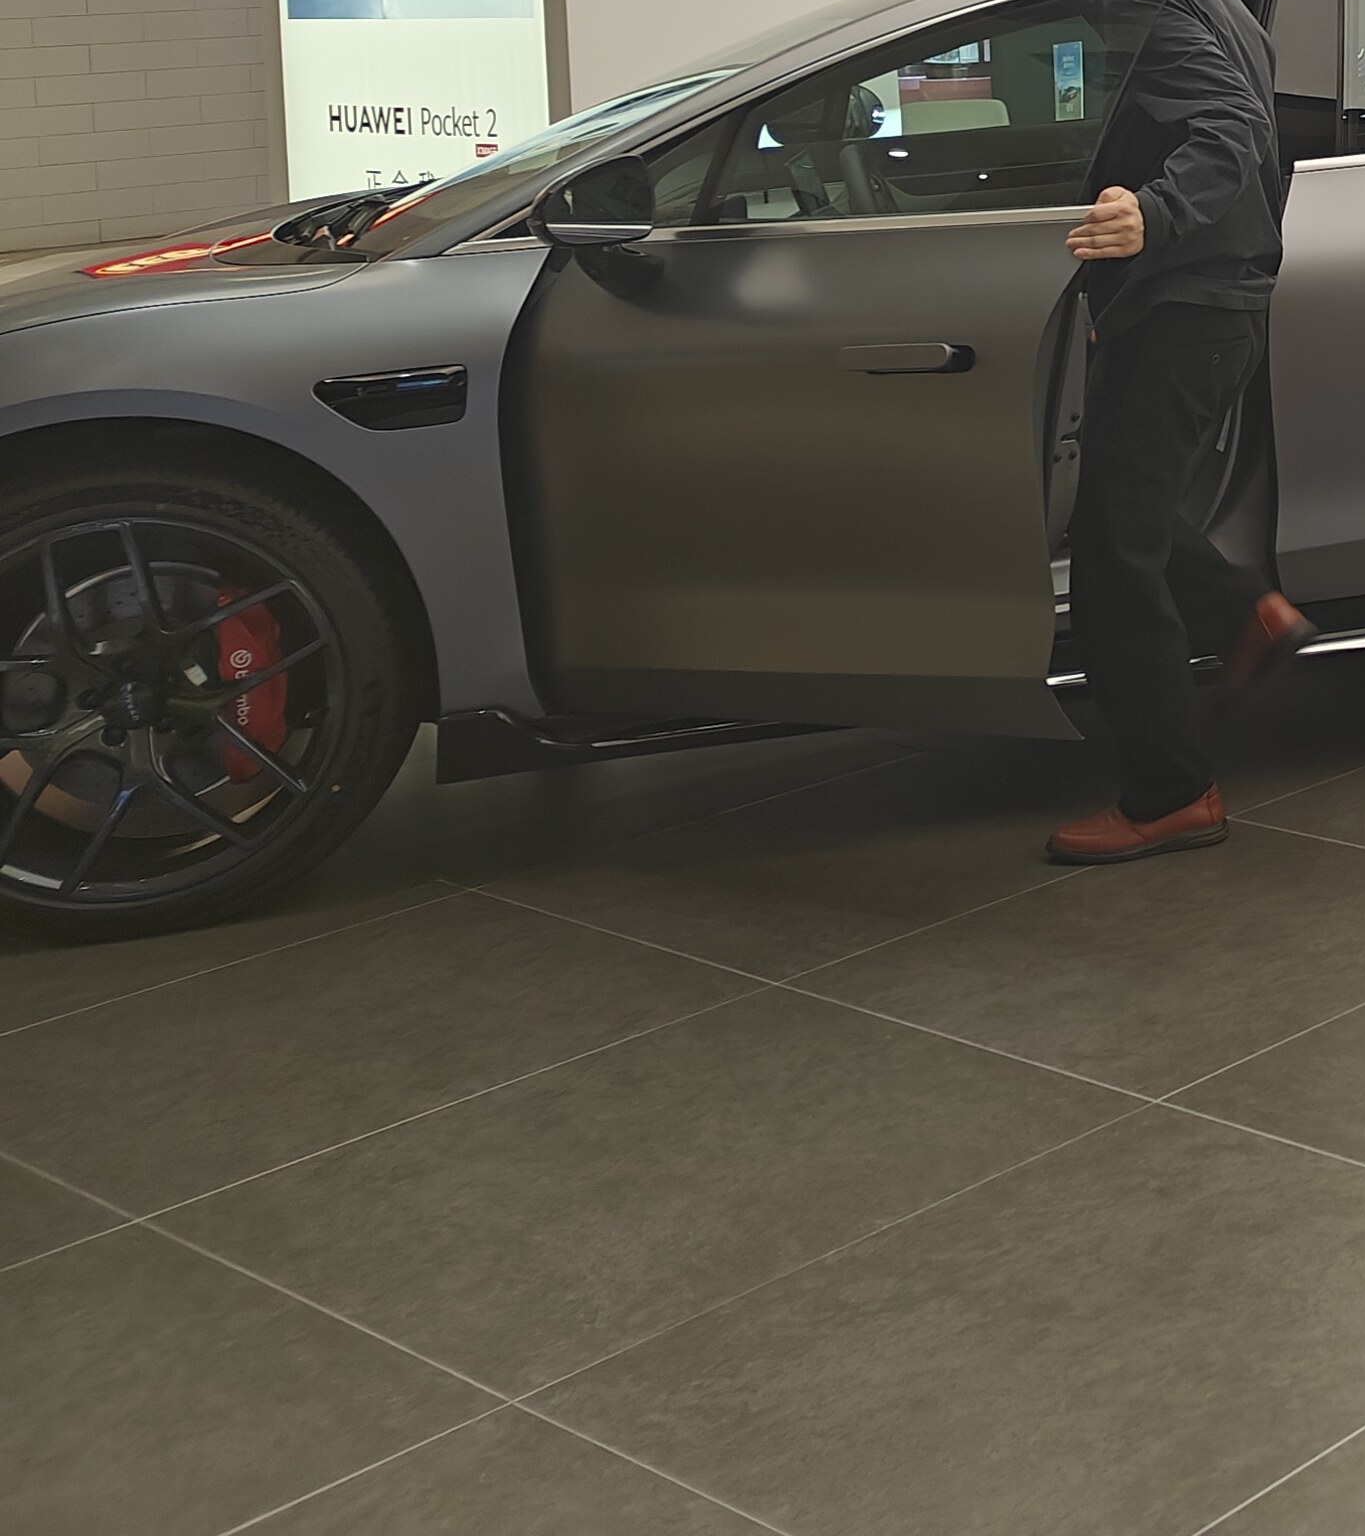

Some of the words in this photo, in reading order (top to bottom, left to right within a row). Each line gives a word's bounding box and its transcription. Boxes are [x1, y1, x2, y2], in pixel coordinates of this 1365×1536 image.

[328, 104, 412, 135] HUAWEI
[420, 106, 480, 137] Pocket
[486, 109, 498, 137] 2
[235, 669, 251, 725] bmbo
